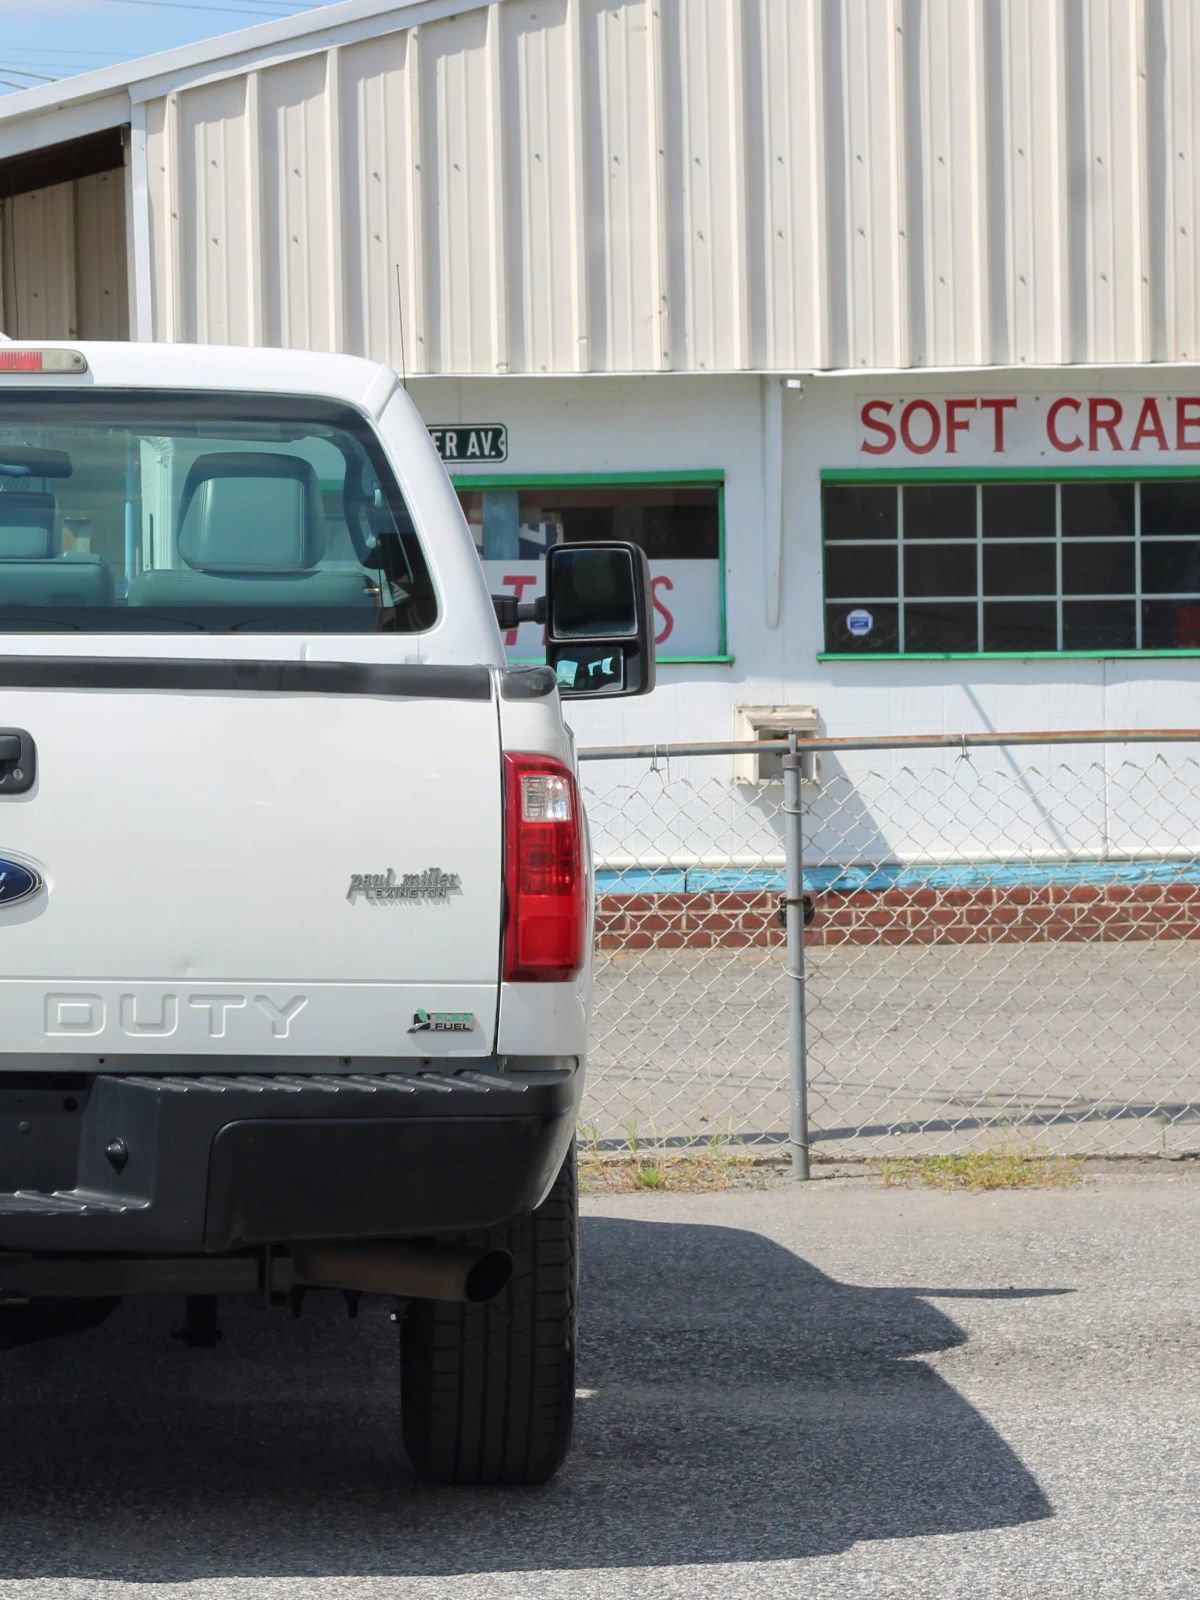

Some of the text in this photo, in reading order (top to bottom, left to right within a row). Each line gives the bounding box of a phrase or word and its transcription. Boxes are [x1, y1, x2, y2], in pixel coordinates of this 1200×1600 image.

[860, 397, 1200, 455] SOFT CRAB
[466, 431, 496, 456] AV.
[400, 867, 460, 888] miller
[365, 888, 448, 900] LEXINGTON
[43, 991, 308, 1039] DUTY
[434, 1023, 472, 1031] FUEL
